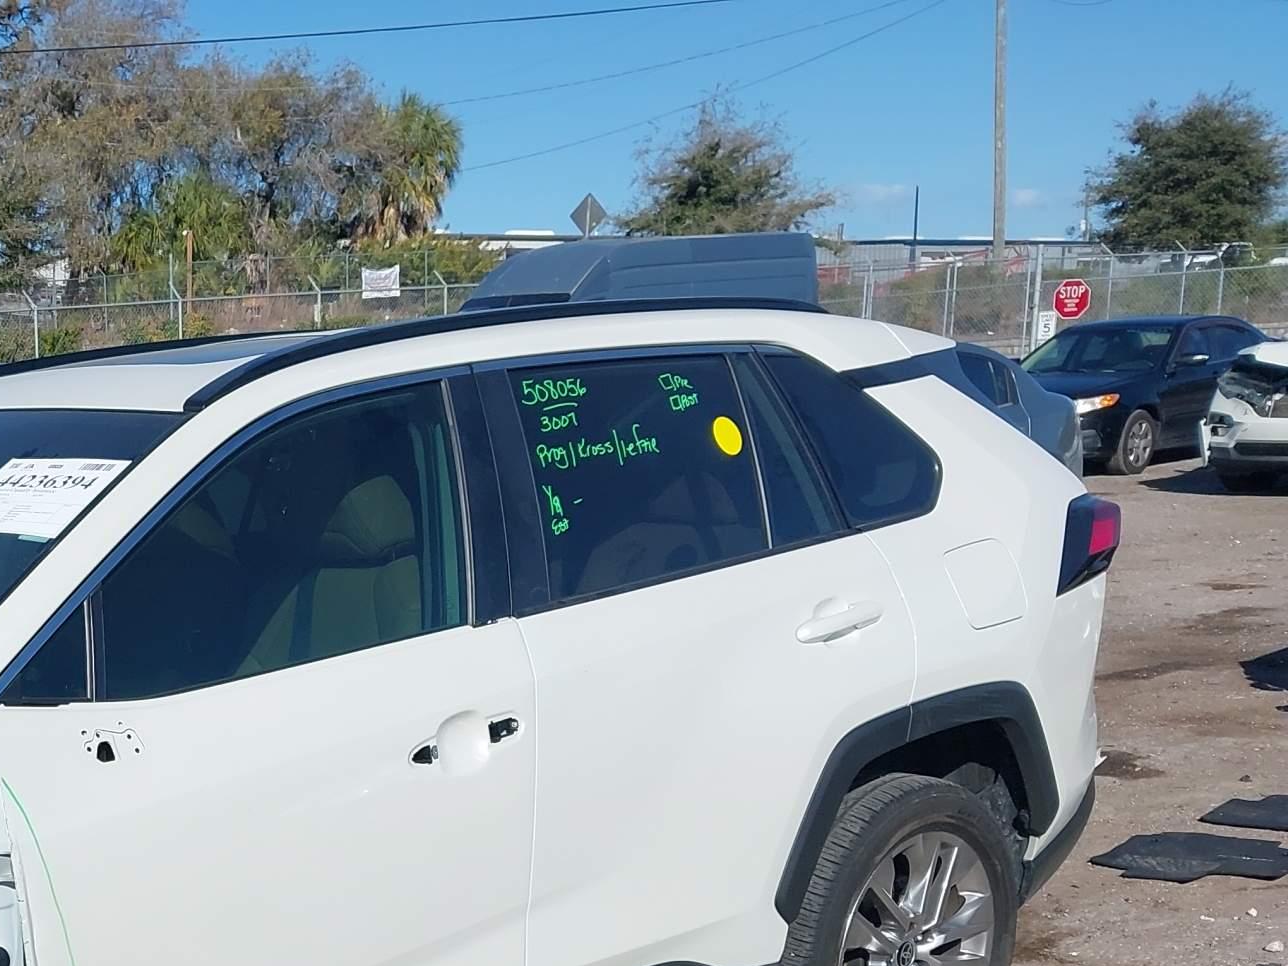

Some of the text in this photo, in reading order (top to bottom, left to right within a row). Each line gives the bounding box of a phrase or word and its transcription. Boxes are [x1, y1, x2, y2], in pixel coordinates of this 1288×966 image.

[1059, 285, 1086, 299] STOP
[1043, 323, 1050, 333] 5
[521, 378, 587, 405] 508056
[540, 411, 578, 432] 3007
